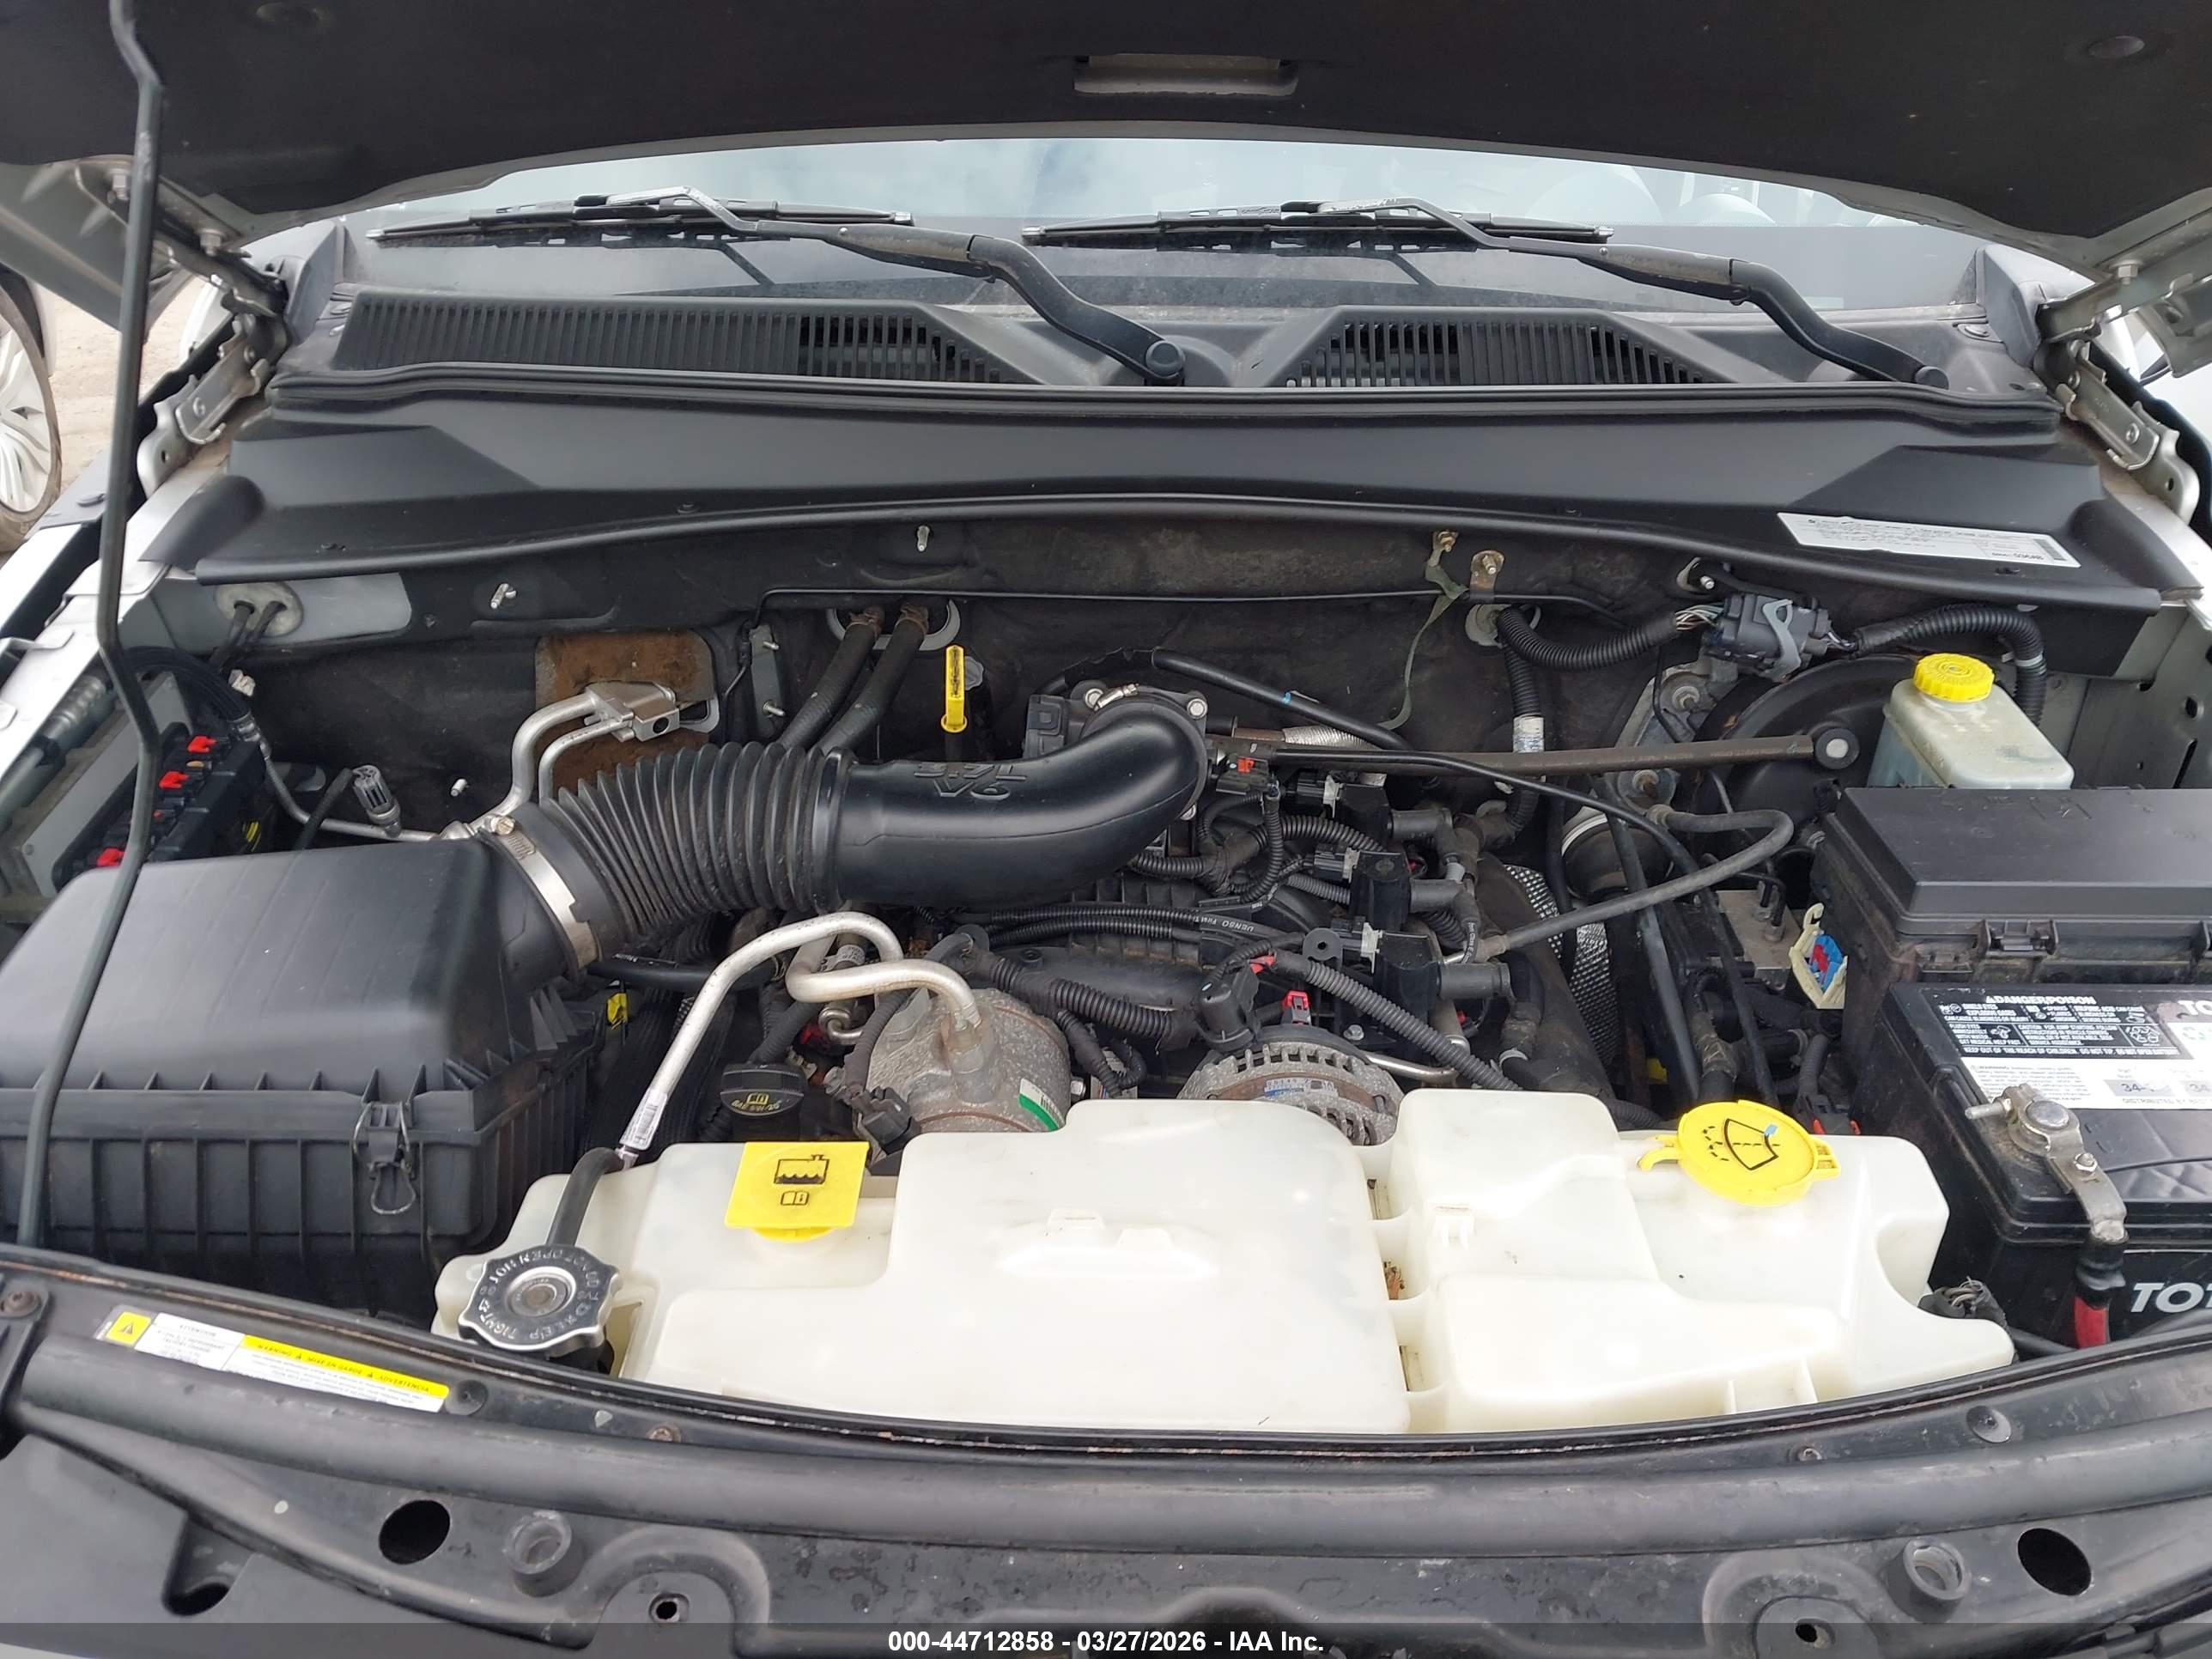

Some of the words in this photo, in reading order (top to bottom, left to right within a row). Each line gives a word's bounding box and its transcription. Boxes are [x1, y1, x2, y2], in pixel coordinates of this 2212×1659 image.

[933, 780, 1012, 800] V6
[1222, 920, 1254, 933] DENSO
[2130, 1282, 2212, 1313] TO
